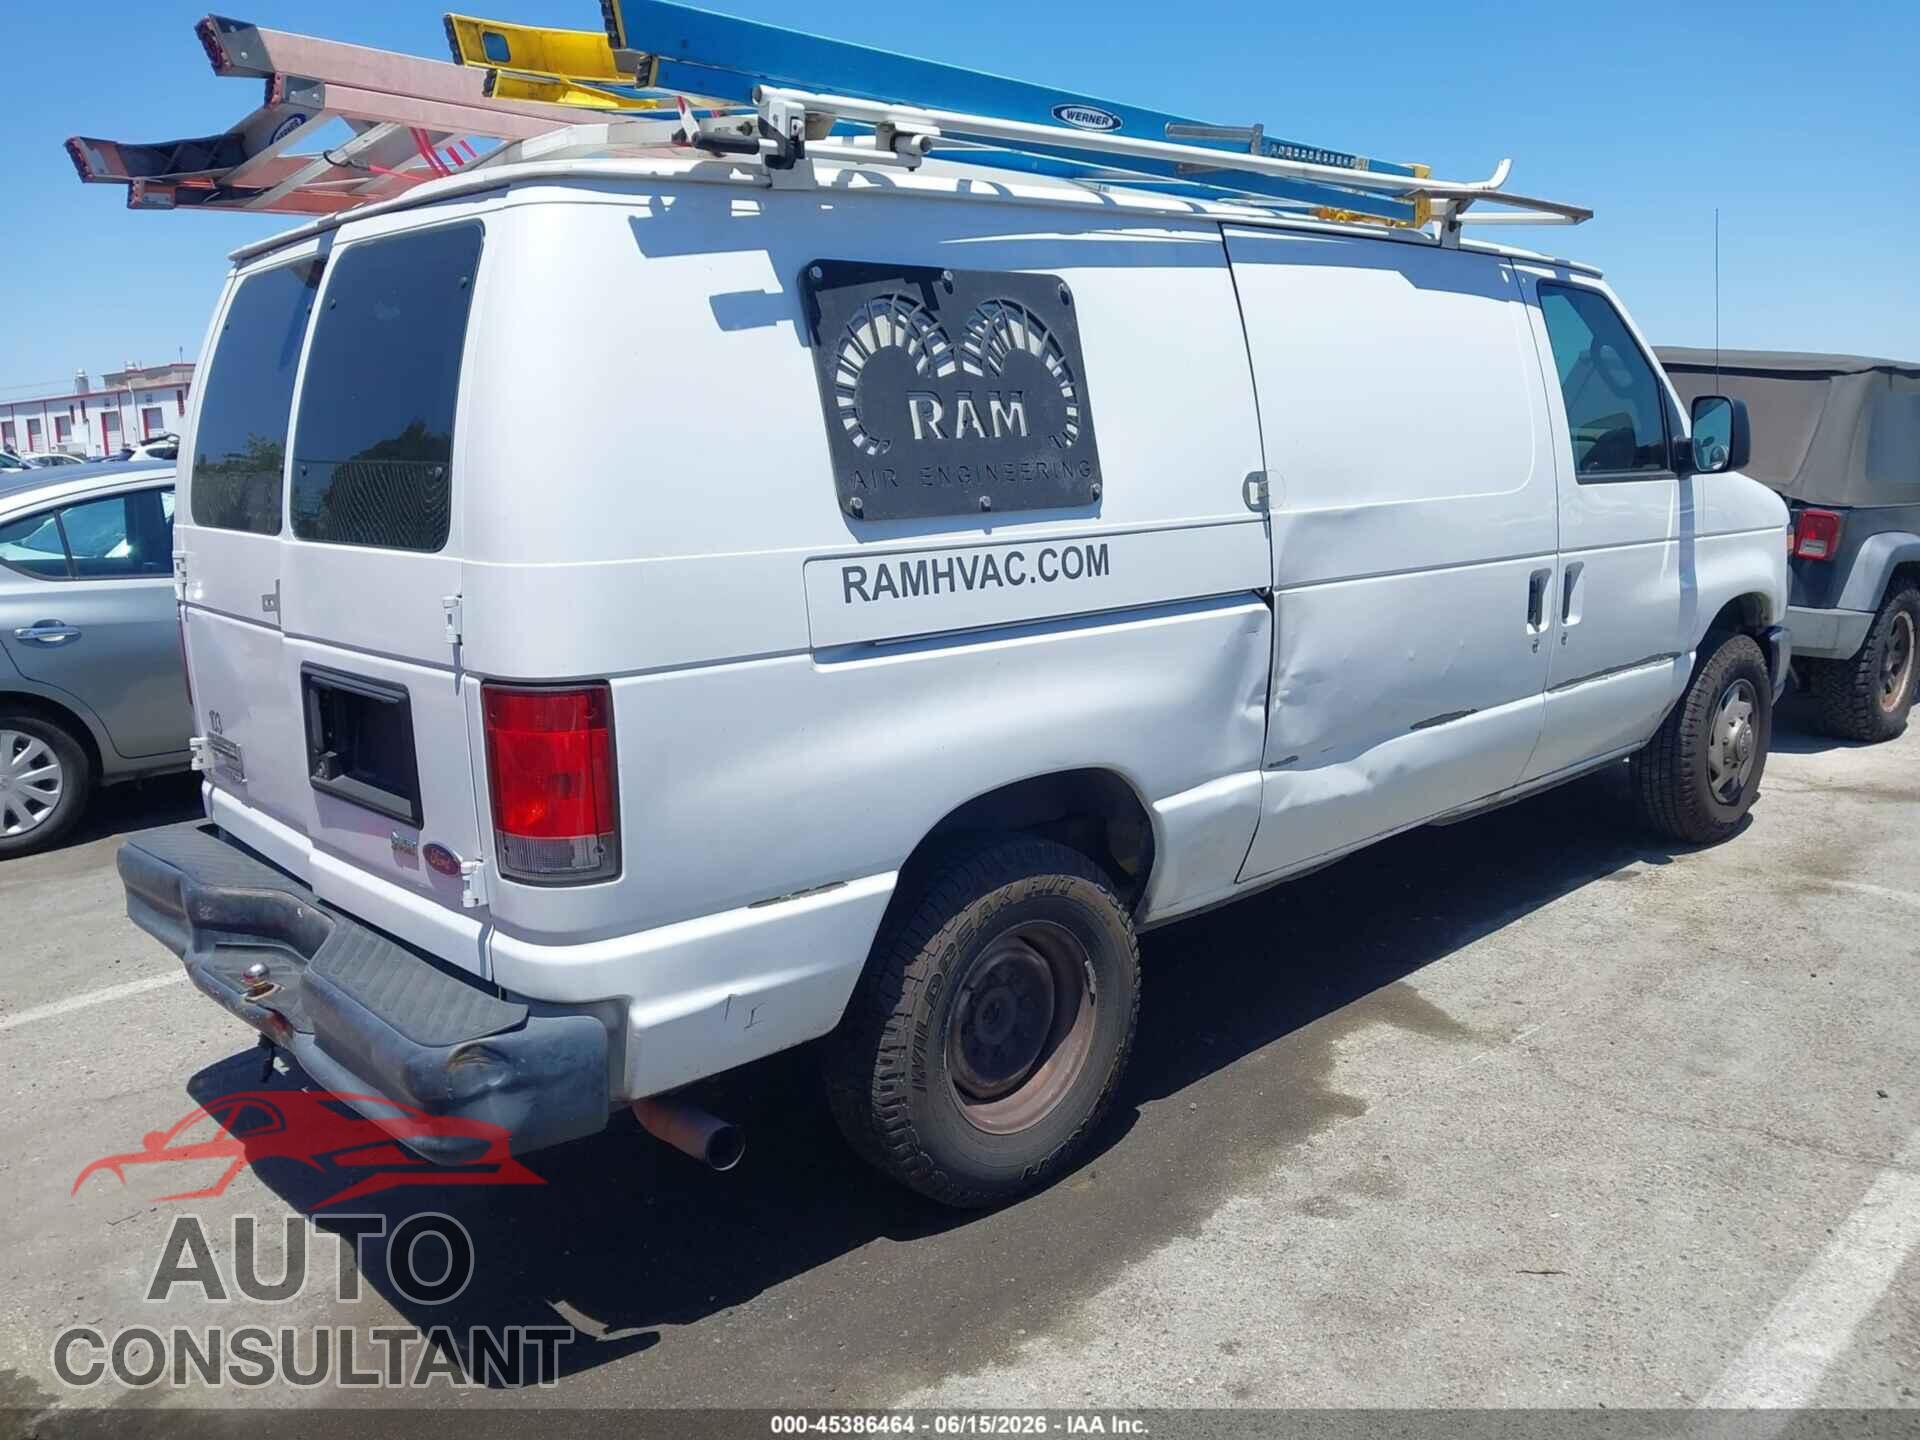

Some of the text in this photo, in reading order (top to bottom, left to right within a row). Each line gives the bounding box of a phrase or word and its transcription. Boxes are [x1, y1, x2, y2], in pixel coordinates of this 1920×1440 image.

[1066, 110, 1110, 126] WERNER
[906, 390, 1031, 441] RAM
[852, 459, 1093, 490] AIR ENGINEERING
[841, 543, 1110, 604] RAMHVAC.COM
